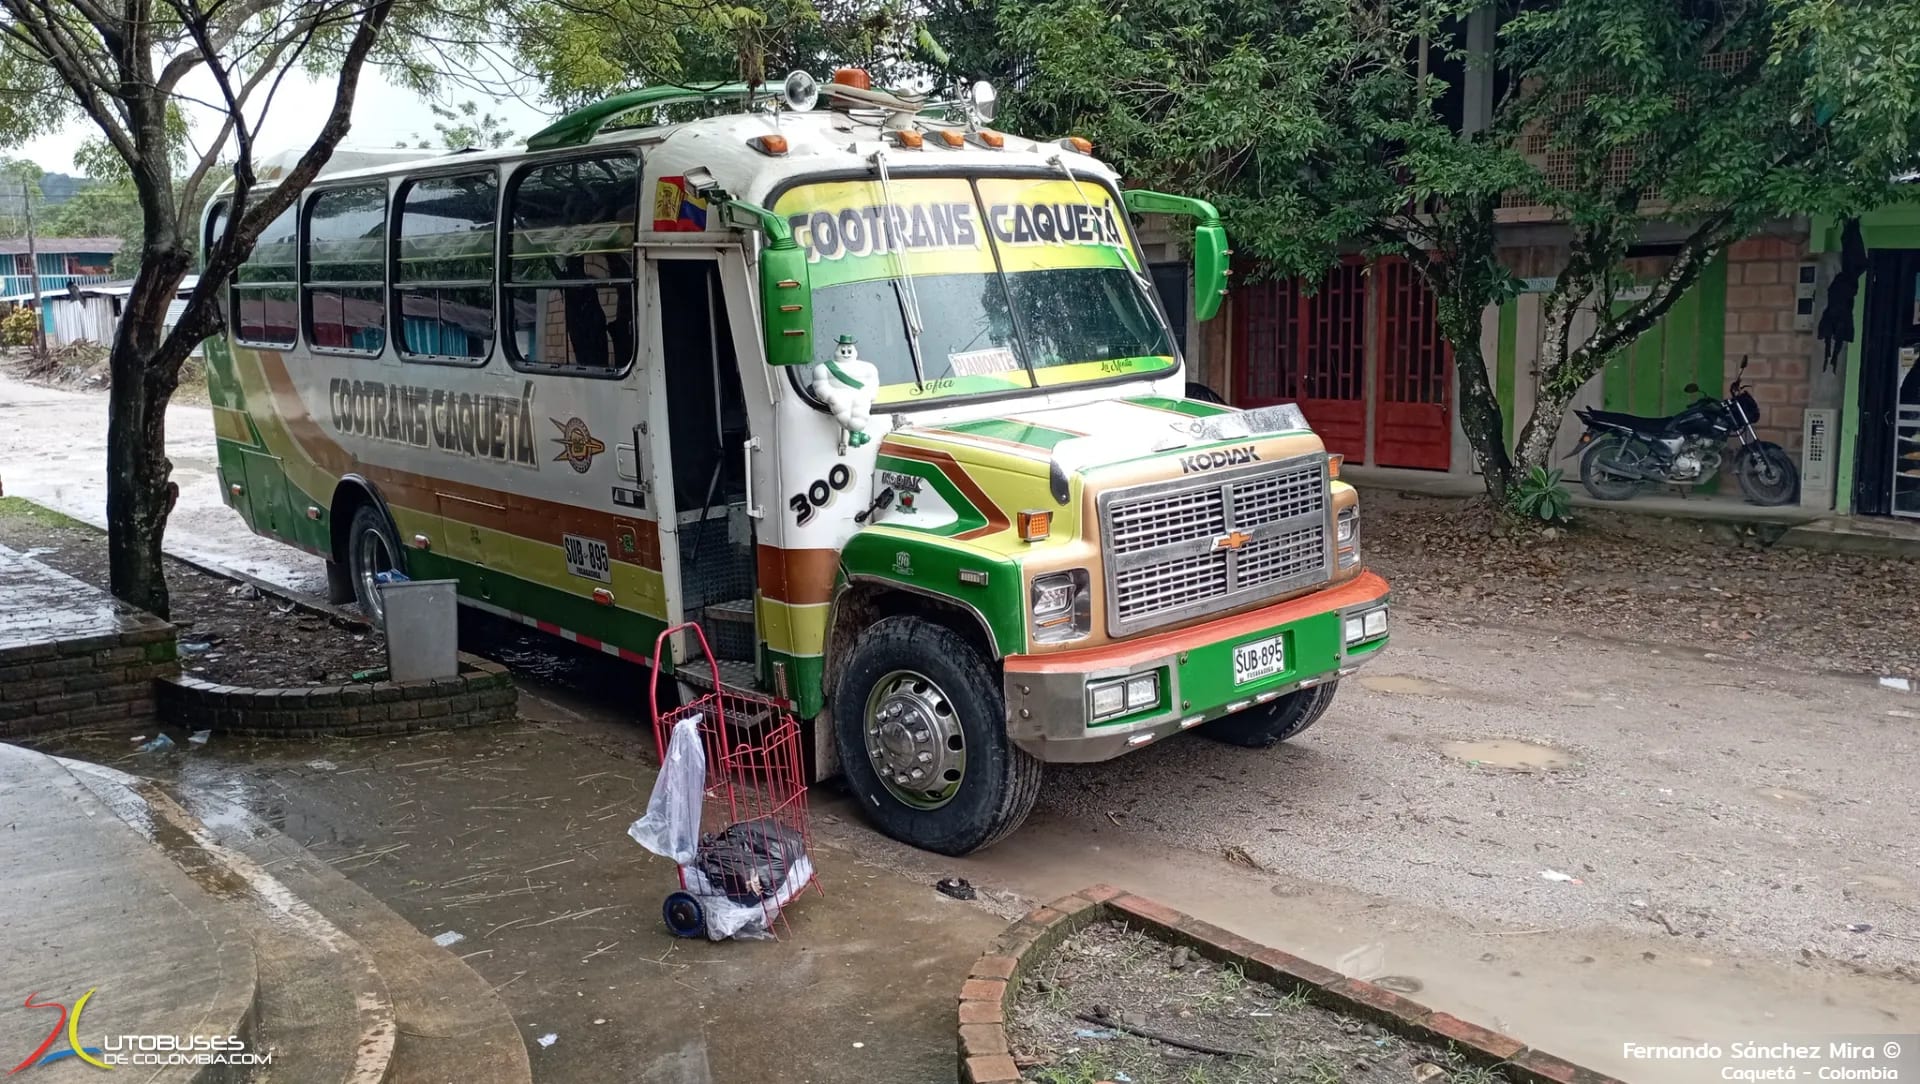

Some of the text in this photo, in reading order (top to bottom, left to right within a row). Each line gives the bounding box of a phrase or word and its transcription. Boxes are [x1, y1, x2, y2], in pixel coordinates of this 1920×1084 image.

[788, 198, 1124, 261] COOTRANS CAQUETÁ
[953, 352, 1016, 376] PIAMONTE
[329, 377, 430, 448] COOTRANS
[431, 379, 540, 471] CAQUETÁ
[1179, 446, 1261, 474] KODIAK
[789, 463, 855, 527] 300
[565, 537, 608, 572] SUB-895
